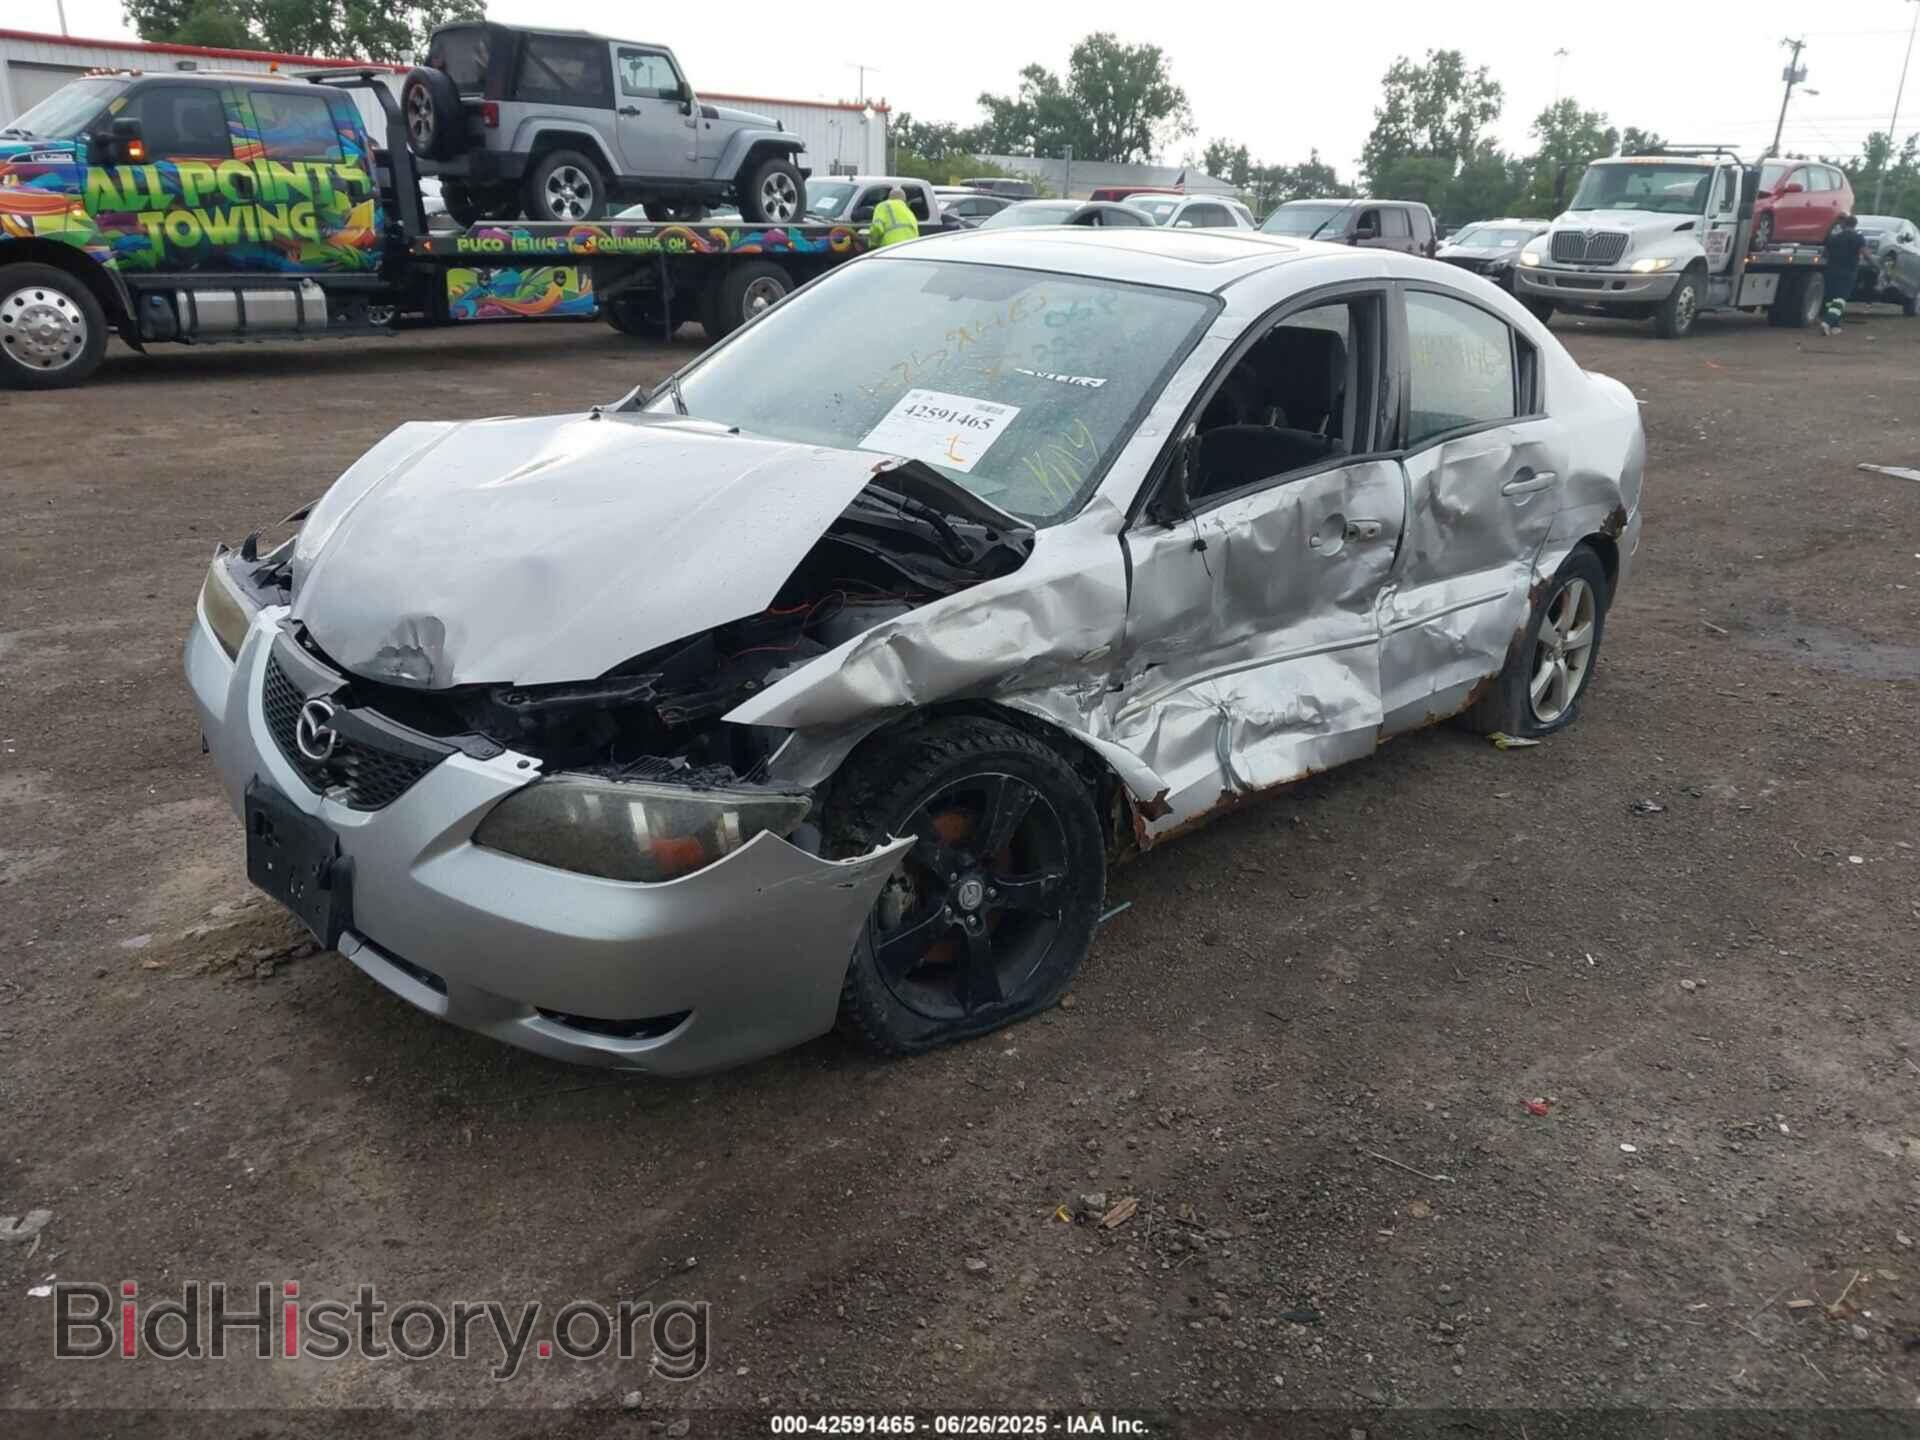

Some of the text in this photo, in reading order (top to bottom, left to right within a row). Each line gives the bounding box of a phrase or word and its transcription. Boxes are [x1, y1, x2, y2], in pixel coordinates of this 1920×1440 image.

[85, 164, 175, 214] ALL
[138, 201, 320, 256] TOWING
[457, 238, 503, 251] PUCO
[668, 238, 687, 249] OH
[905, 404, 994, 431] 42591465
